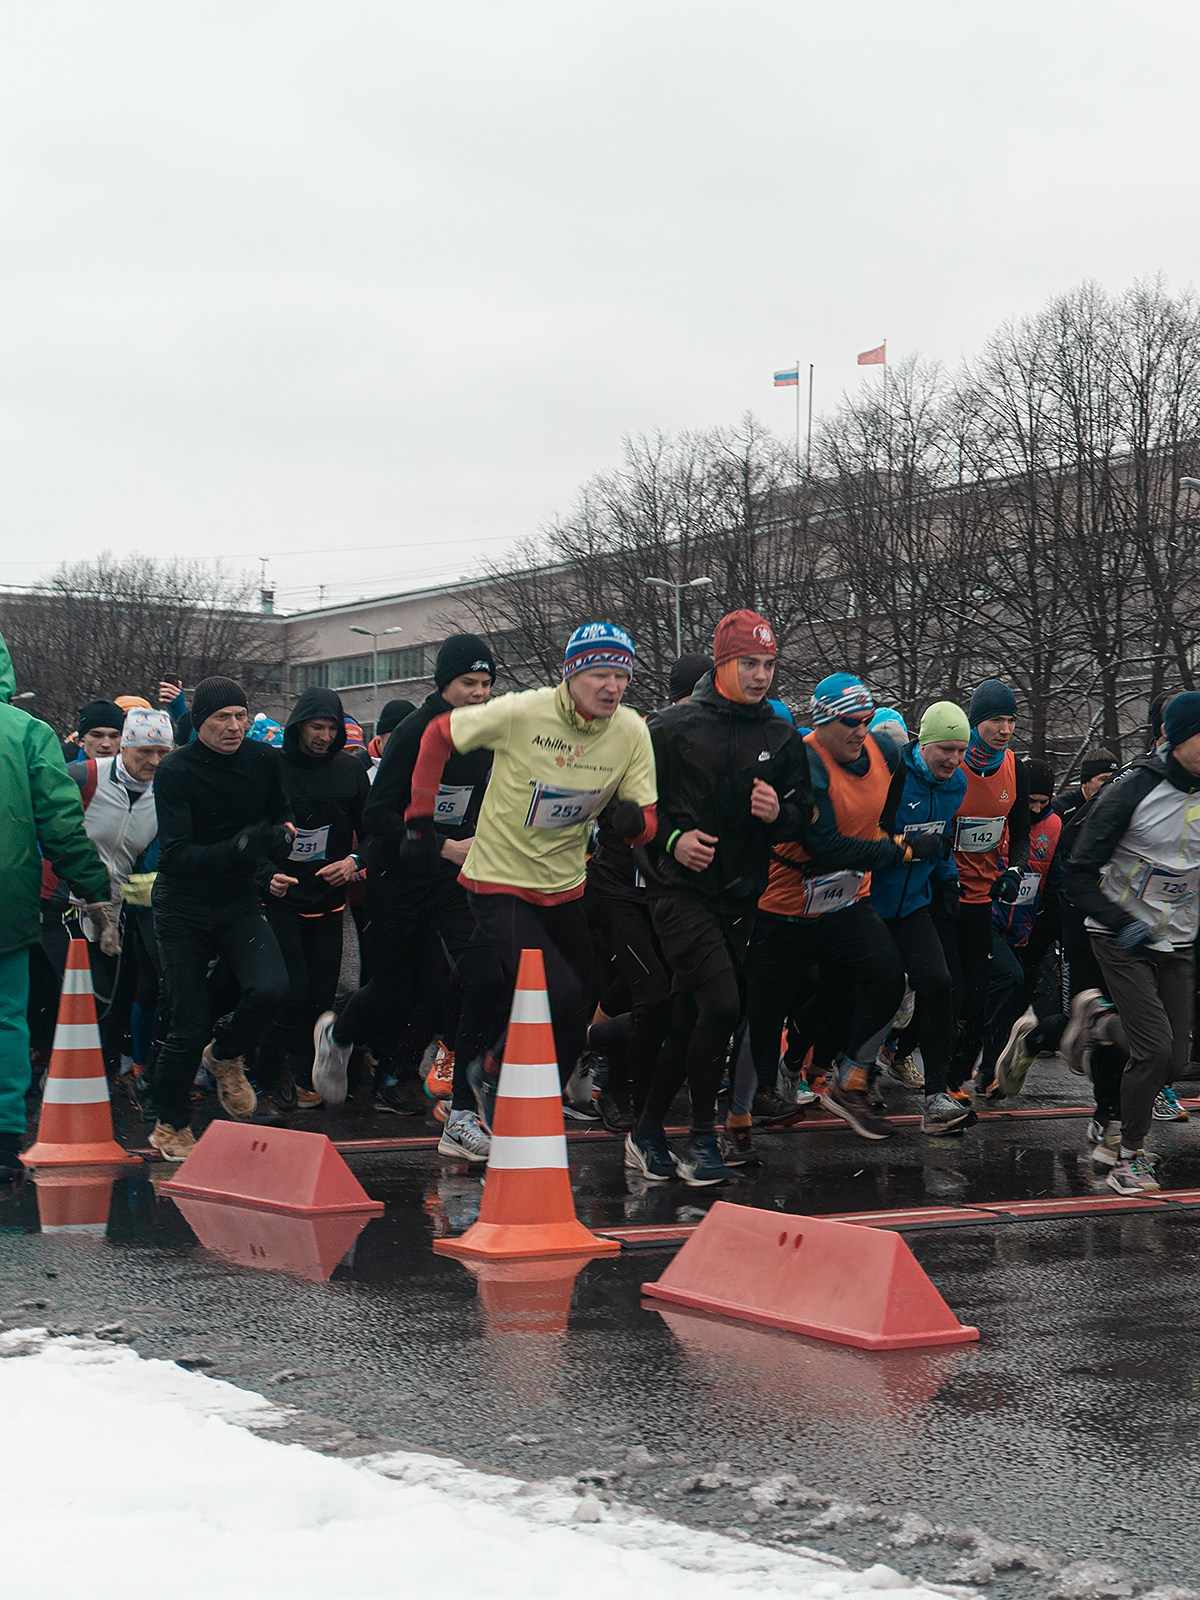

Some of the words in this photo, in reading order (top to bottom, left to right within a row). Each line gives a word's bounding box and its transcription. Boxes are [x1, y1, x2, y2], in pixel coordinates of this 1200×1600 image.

[531, 735, 573, 753] Achilles
[437, 801, 456, 813] 65
[550, 803, 582, 818] 252
[971, 832, 993, 843] 142
[296, 842, 317, 852] 231
[823, 888, 844, 900] 144
[1020, 886, 1032, 896] 07
